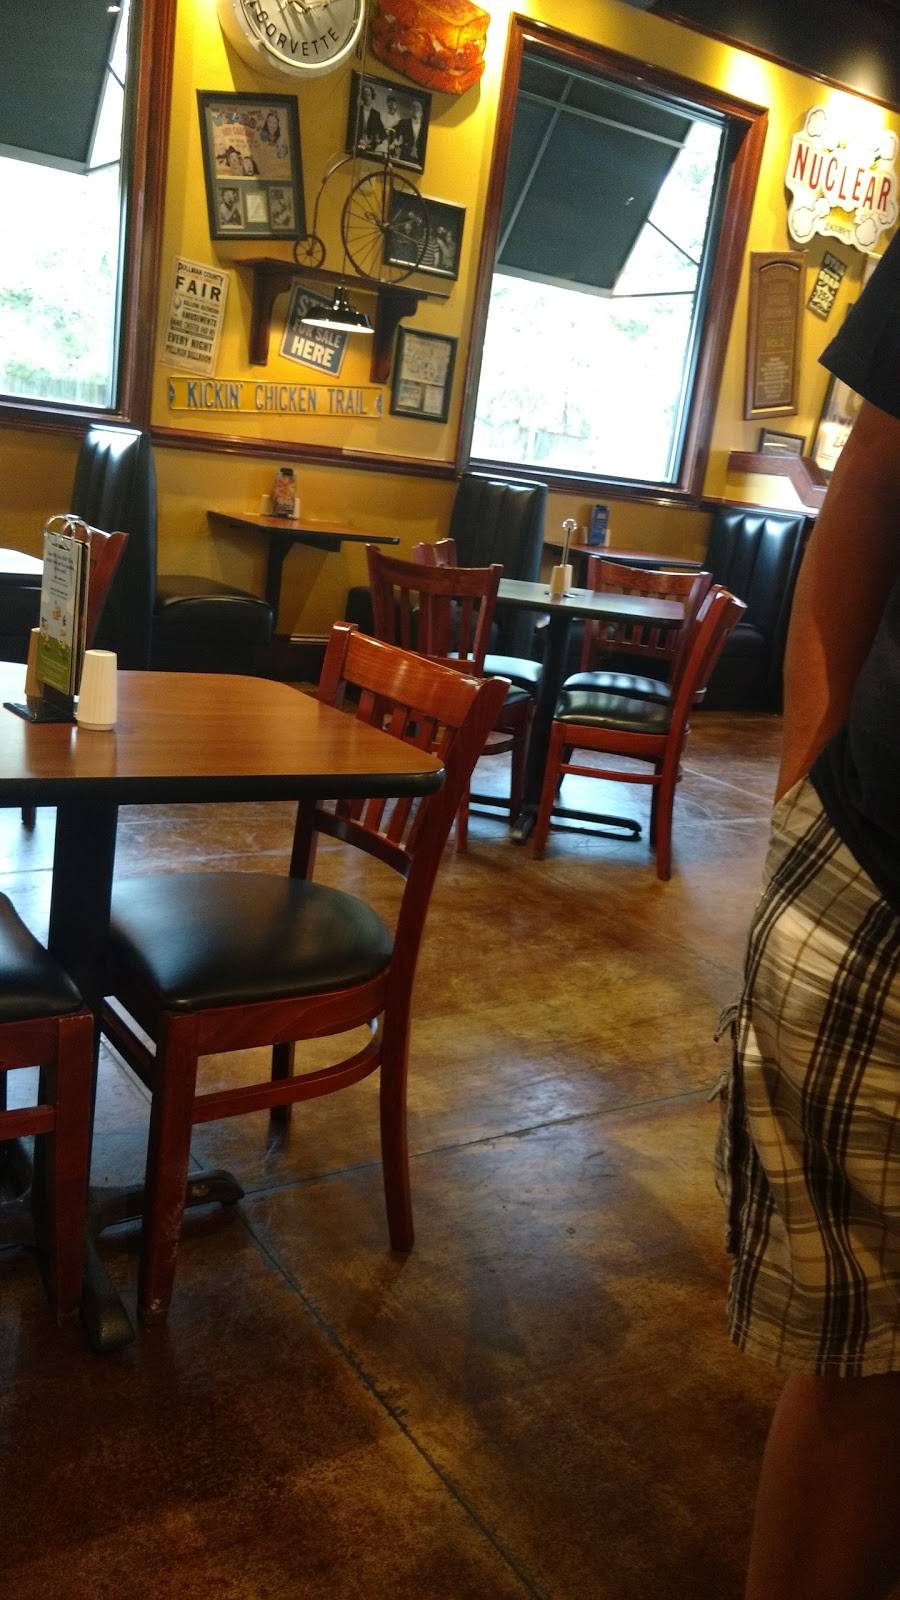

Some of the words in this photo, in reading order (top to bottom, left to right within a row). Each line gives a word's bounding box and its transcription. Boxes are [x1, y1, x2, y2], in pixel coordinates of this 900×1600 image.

[257, 10, 340, 56] CORVETTE
[792, 143, 891, 212] NUCLEAR
[175, 276, 222, 302] FAIR
[167, 332, 189, 348] EVERY
[191, 338, 213, 353] NIGHT
[291, 335, 335, 368] HERE
[315, 327, 342, 348] SALE
[187, 381, 243, 409] KICKIN'
[255, 384, 317, 413] CHICKEN
[327, 387, 367, 415] TRAIL
